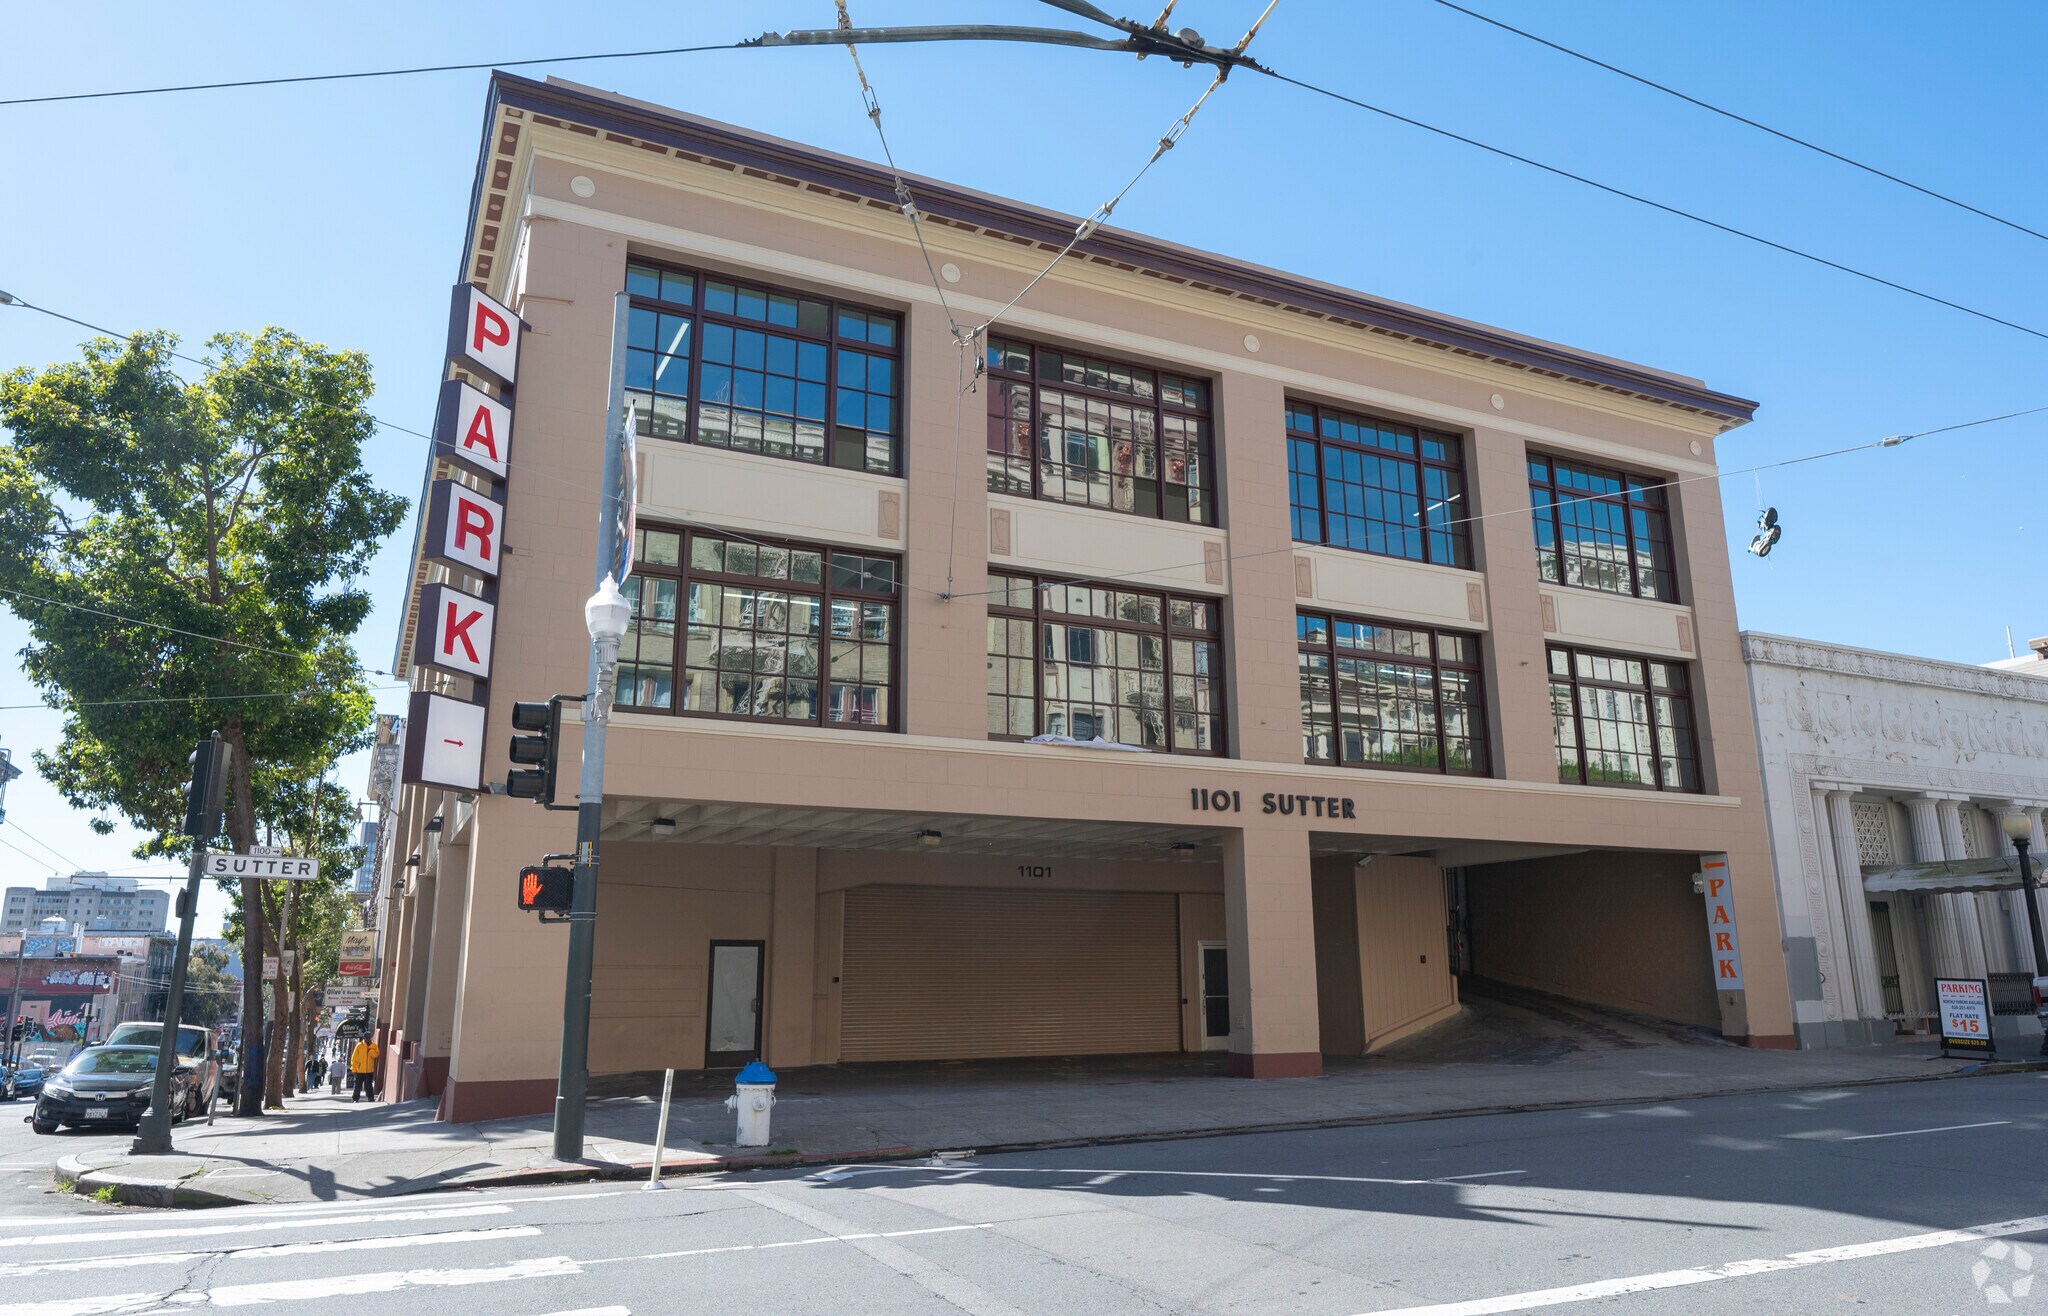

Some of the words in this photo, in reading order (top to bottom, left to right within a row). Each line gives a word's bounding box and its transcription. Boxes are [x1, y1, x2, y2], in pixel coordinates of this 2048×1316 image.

[443, 300, 511, 665] PARK
[1191, 788, 1241, 812] 1101
[1262, 792, 1357, 819] SUTTER
[254, 847, 271, 855] 1100
[214, 858, 311, 876] SUTTER
[1017, 865, 1052, 878] 1101
[1709, 878, 1738, 979] PARK
[1941, 983, 1982, 993] PARKING
[1951, 1018, 1979, 1033] $15
